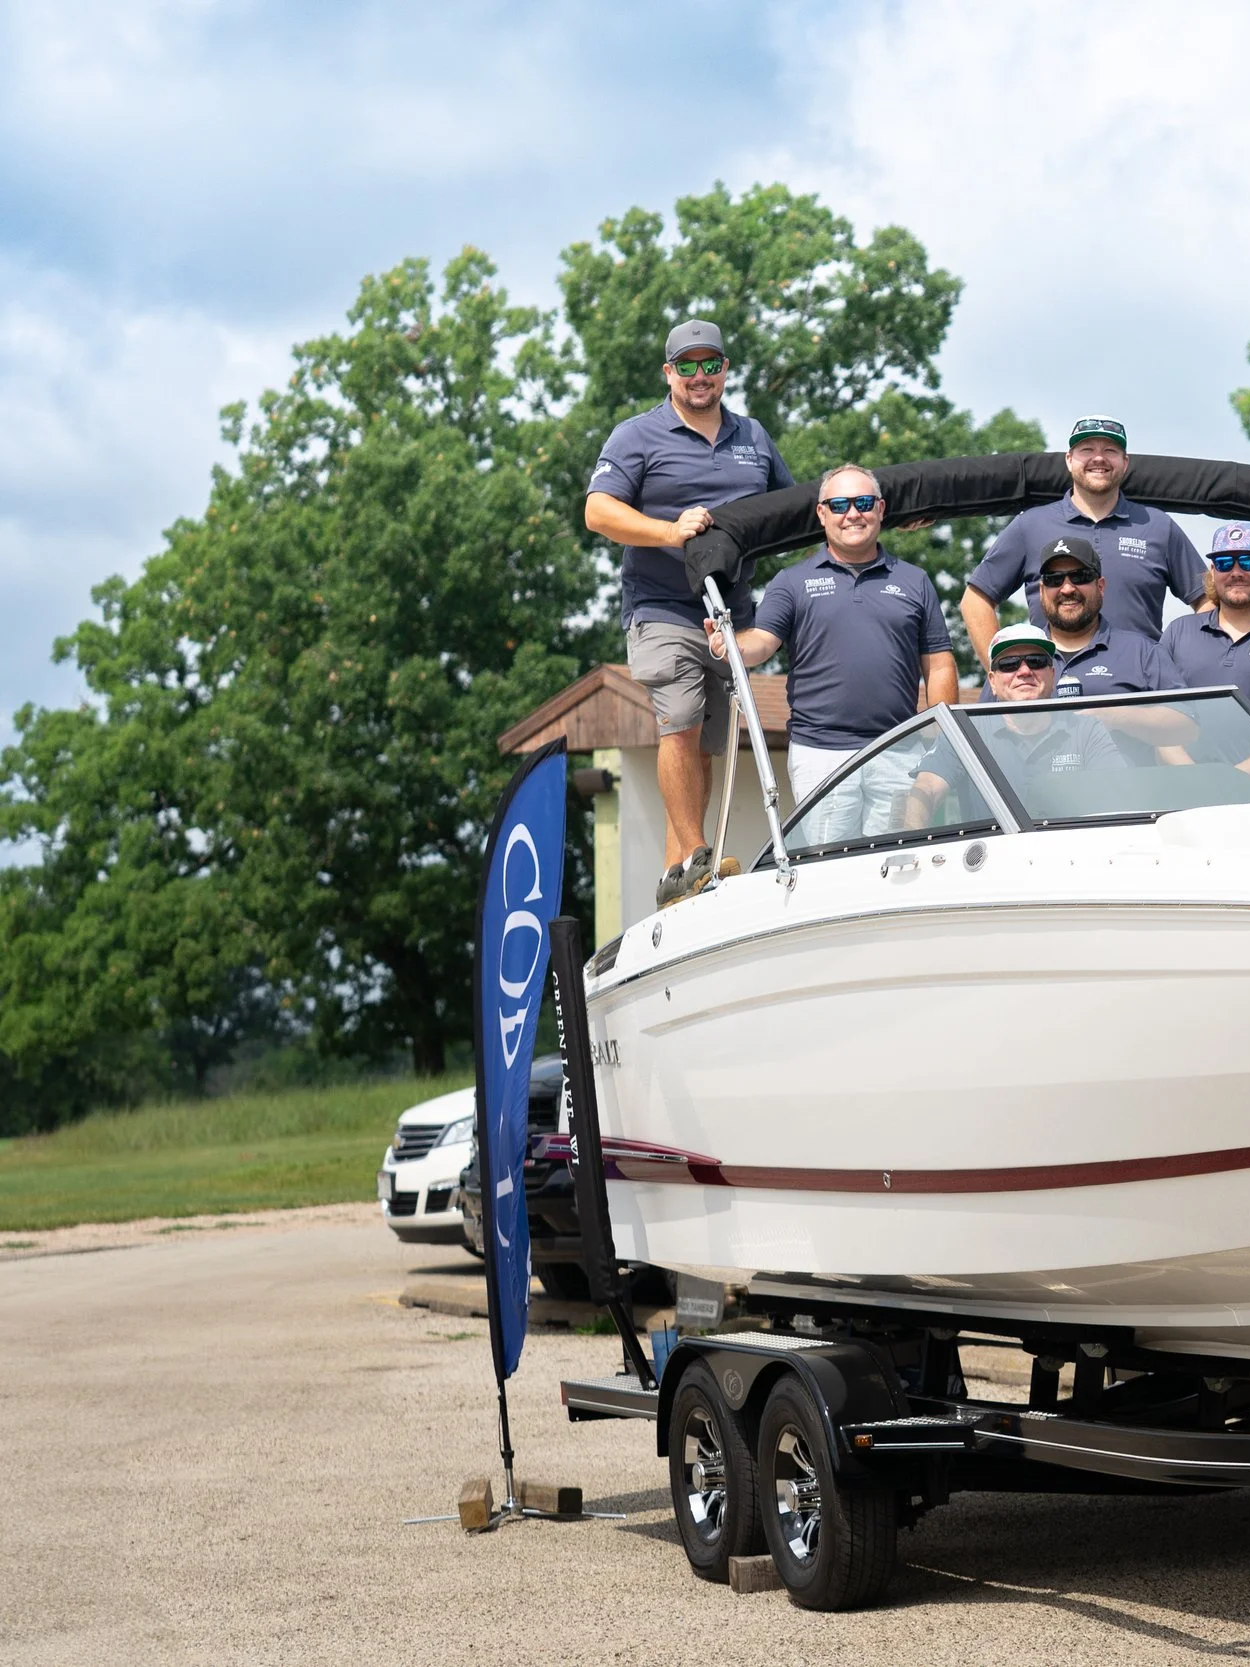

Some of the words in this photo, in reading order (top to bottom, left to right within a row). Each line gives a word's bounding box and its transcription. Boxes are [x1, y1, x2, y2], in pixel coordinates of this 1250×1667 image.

[1119, 537, 1146, 548] SHORELINE
[805, 577, 834, 587] SHORELINE
[590, 1040, 621, 1068] BALT
